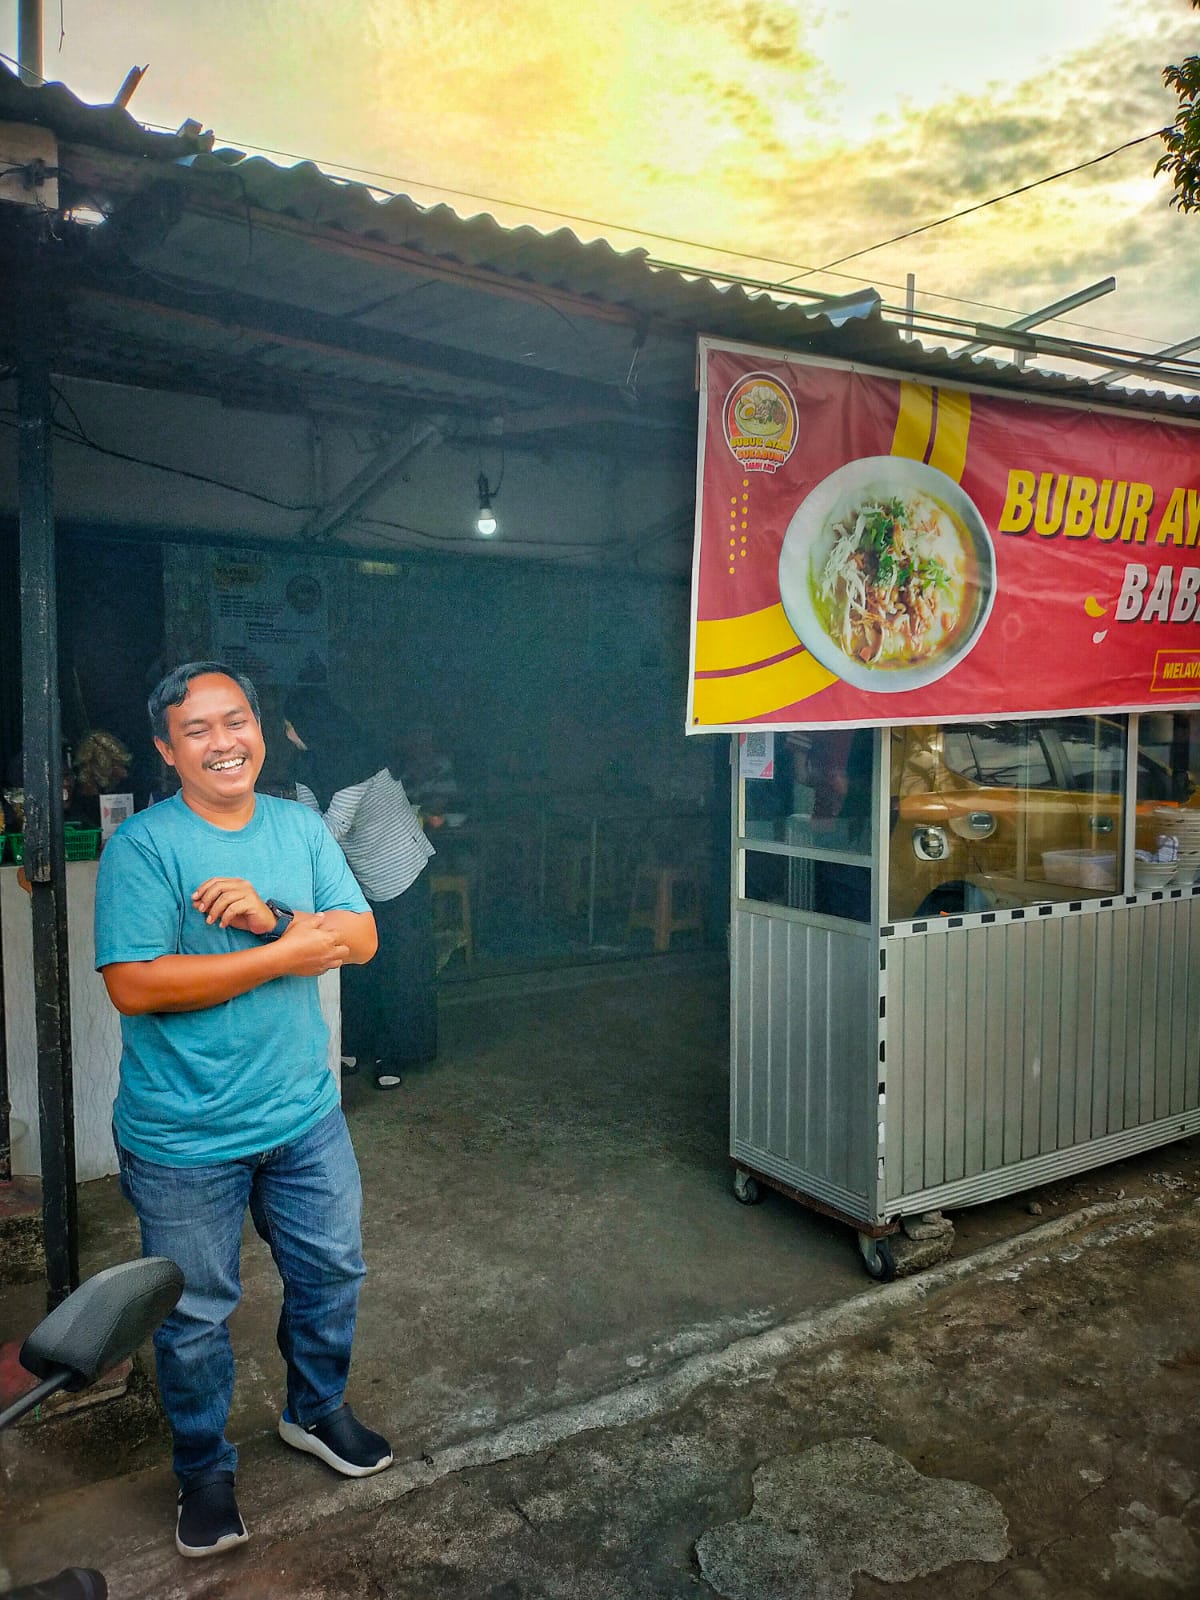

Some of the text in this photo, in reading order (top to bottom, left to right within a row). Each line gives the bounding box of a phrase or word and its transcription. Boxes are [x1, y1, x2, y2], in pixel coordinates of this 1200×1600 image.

[998, 469, 1200, 547] BUBUR AY
[1115, 563, 1200, 624] BAB
